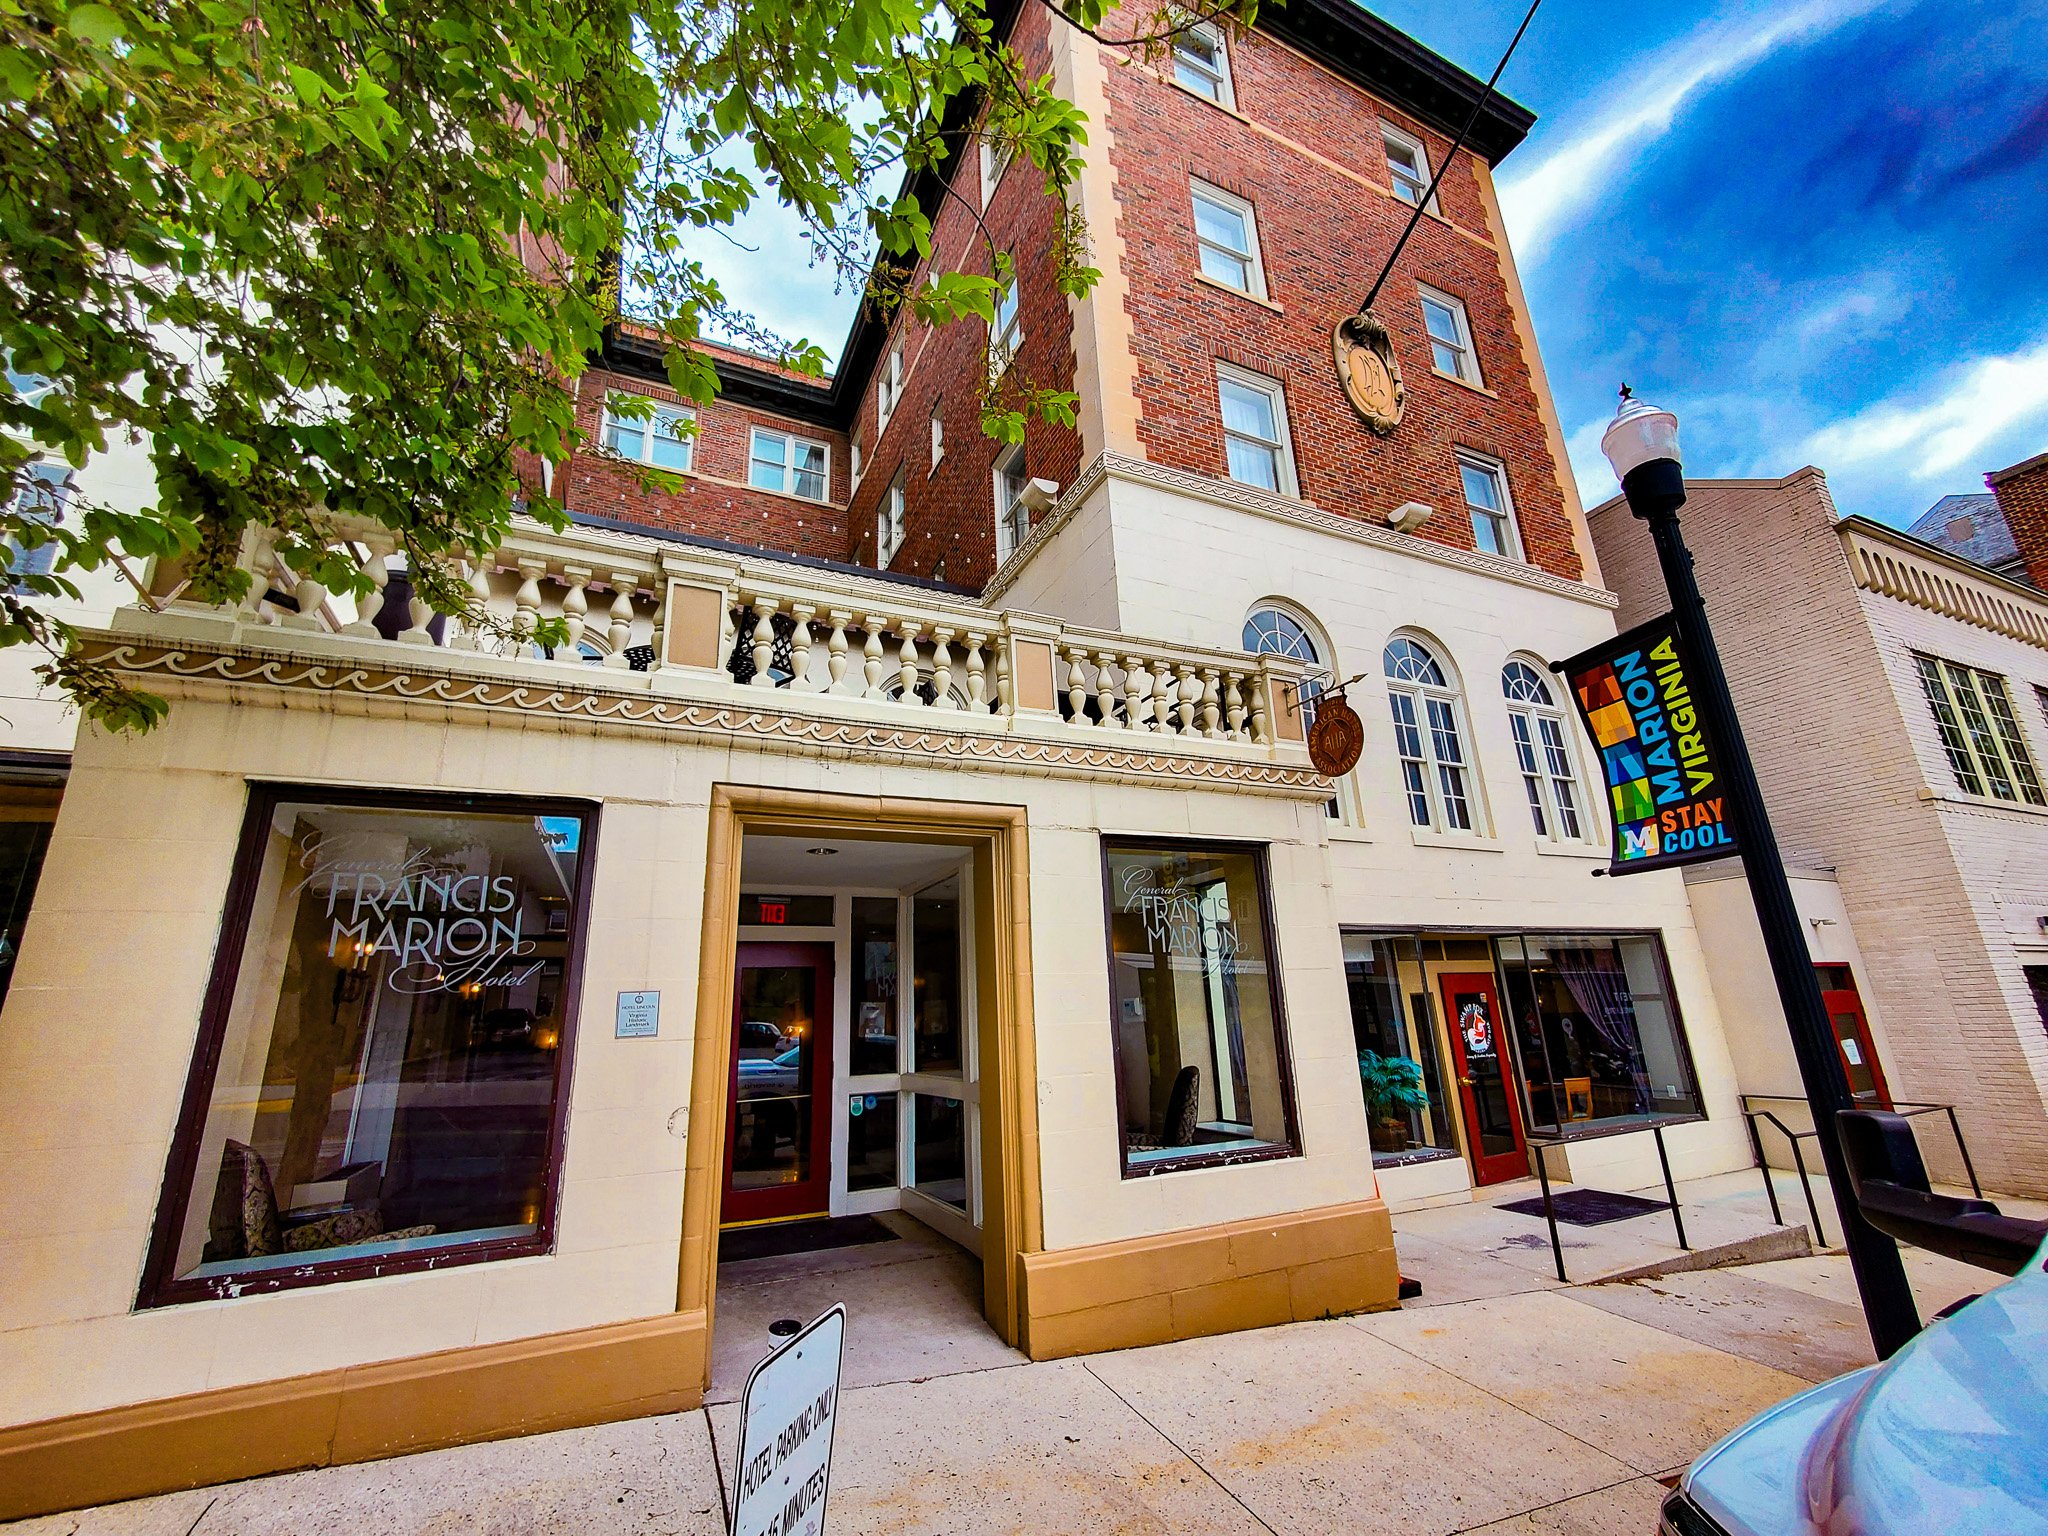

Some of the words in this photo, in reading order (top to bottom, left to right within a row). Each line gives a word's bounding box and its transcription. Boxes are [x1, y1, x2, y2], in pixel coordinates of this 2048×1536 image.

[1311, 708, 1339, 752] AMERICAN
[1340, 708, 1361, 737] HOTEL
[1614, 650, 1685, 806] MARION
[1650, 635, 1714, 796] VIRGINIA
[1315, 742, 1361, 774] ASSOCIATION
[1661, 797, 1723, 833] STAY
[1663, 823, 1732, 854] COOL
[1623, 826, 1655, 855] M
[326, 872, 516, 926] FRANCIS
[1121, 864, 1194, 914] General
[1140, 895, 1232, 932] FRANCIS
[327, 907, 523, 969] MARION
[1147, 919, 1240, 958] MARION
[1200, 943, 1255, 979] Hotel
[389, 941, 546, 994] Hotel
[742, 1442, 773, 1505] HOTEL
[774, 1404, 812, 1471] PARKING
[813, 1384, 835, 1431] ONLY
[781, 1462, 826, 1536] MINUTES
